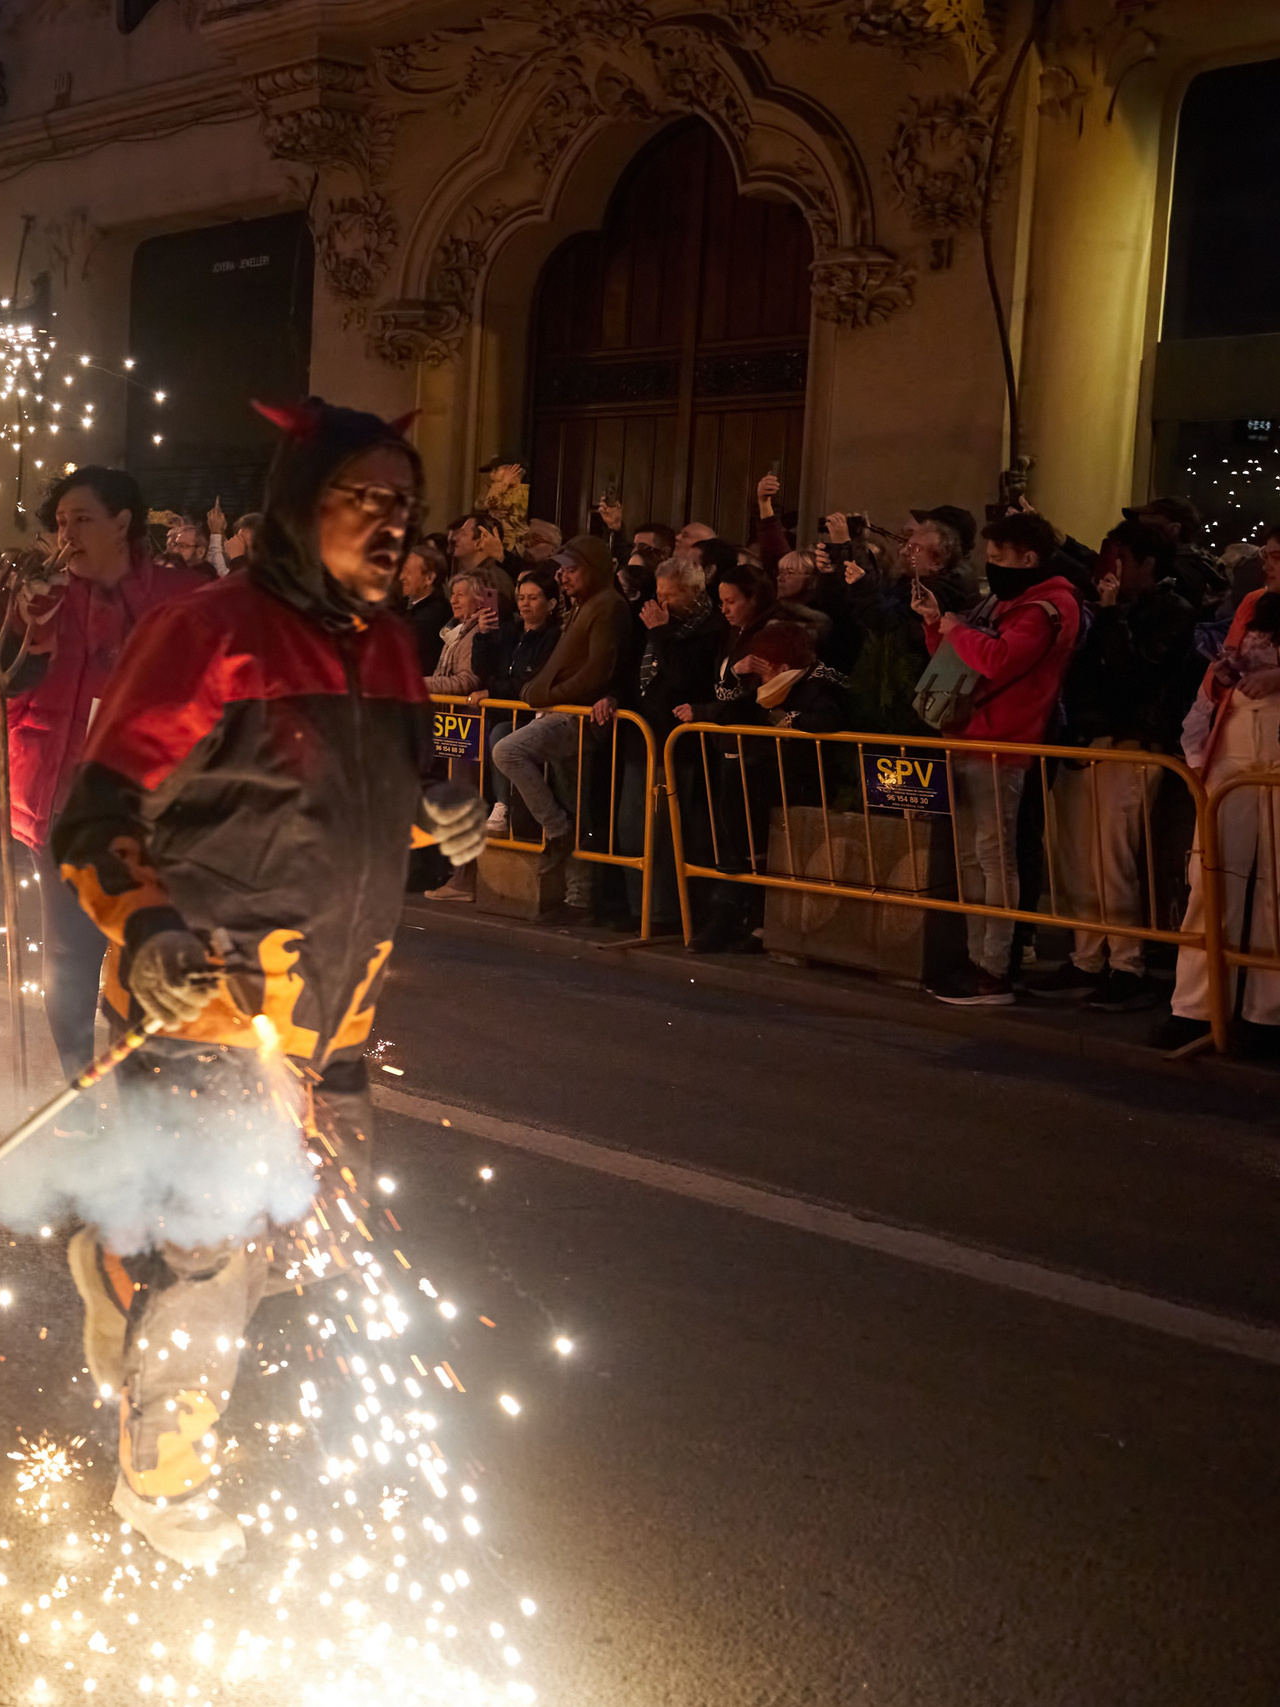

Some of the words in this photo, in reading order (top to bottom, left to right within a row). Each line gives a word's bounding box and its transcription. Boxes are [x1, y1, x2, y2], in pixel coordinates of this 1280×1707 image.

[930, 237, 954, 270] 31
[433, 714, 472, 740] SPV
[876, 758, 934, 788] SPV
[886, 793, 896, 801] 96
[920, 797, 929, 805] 30
